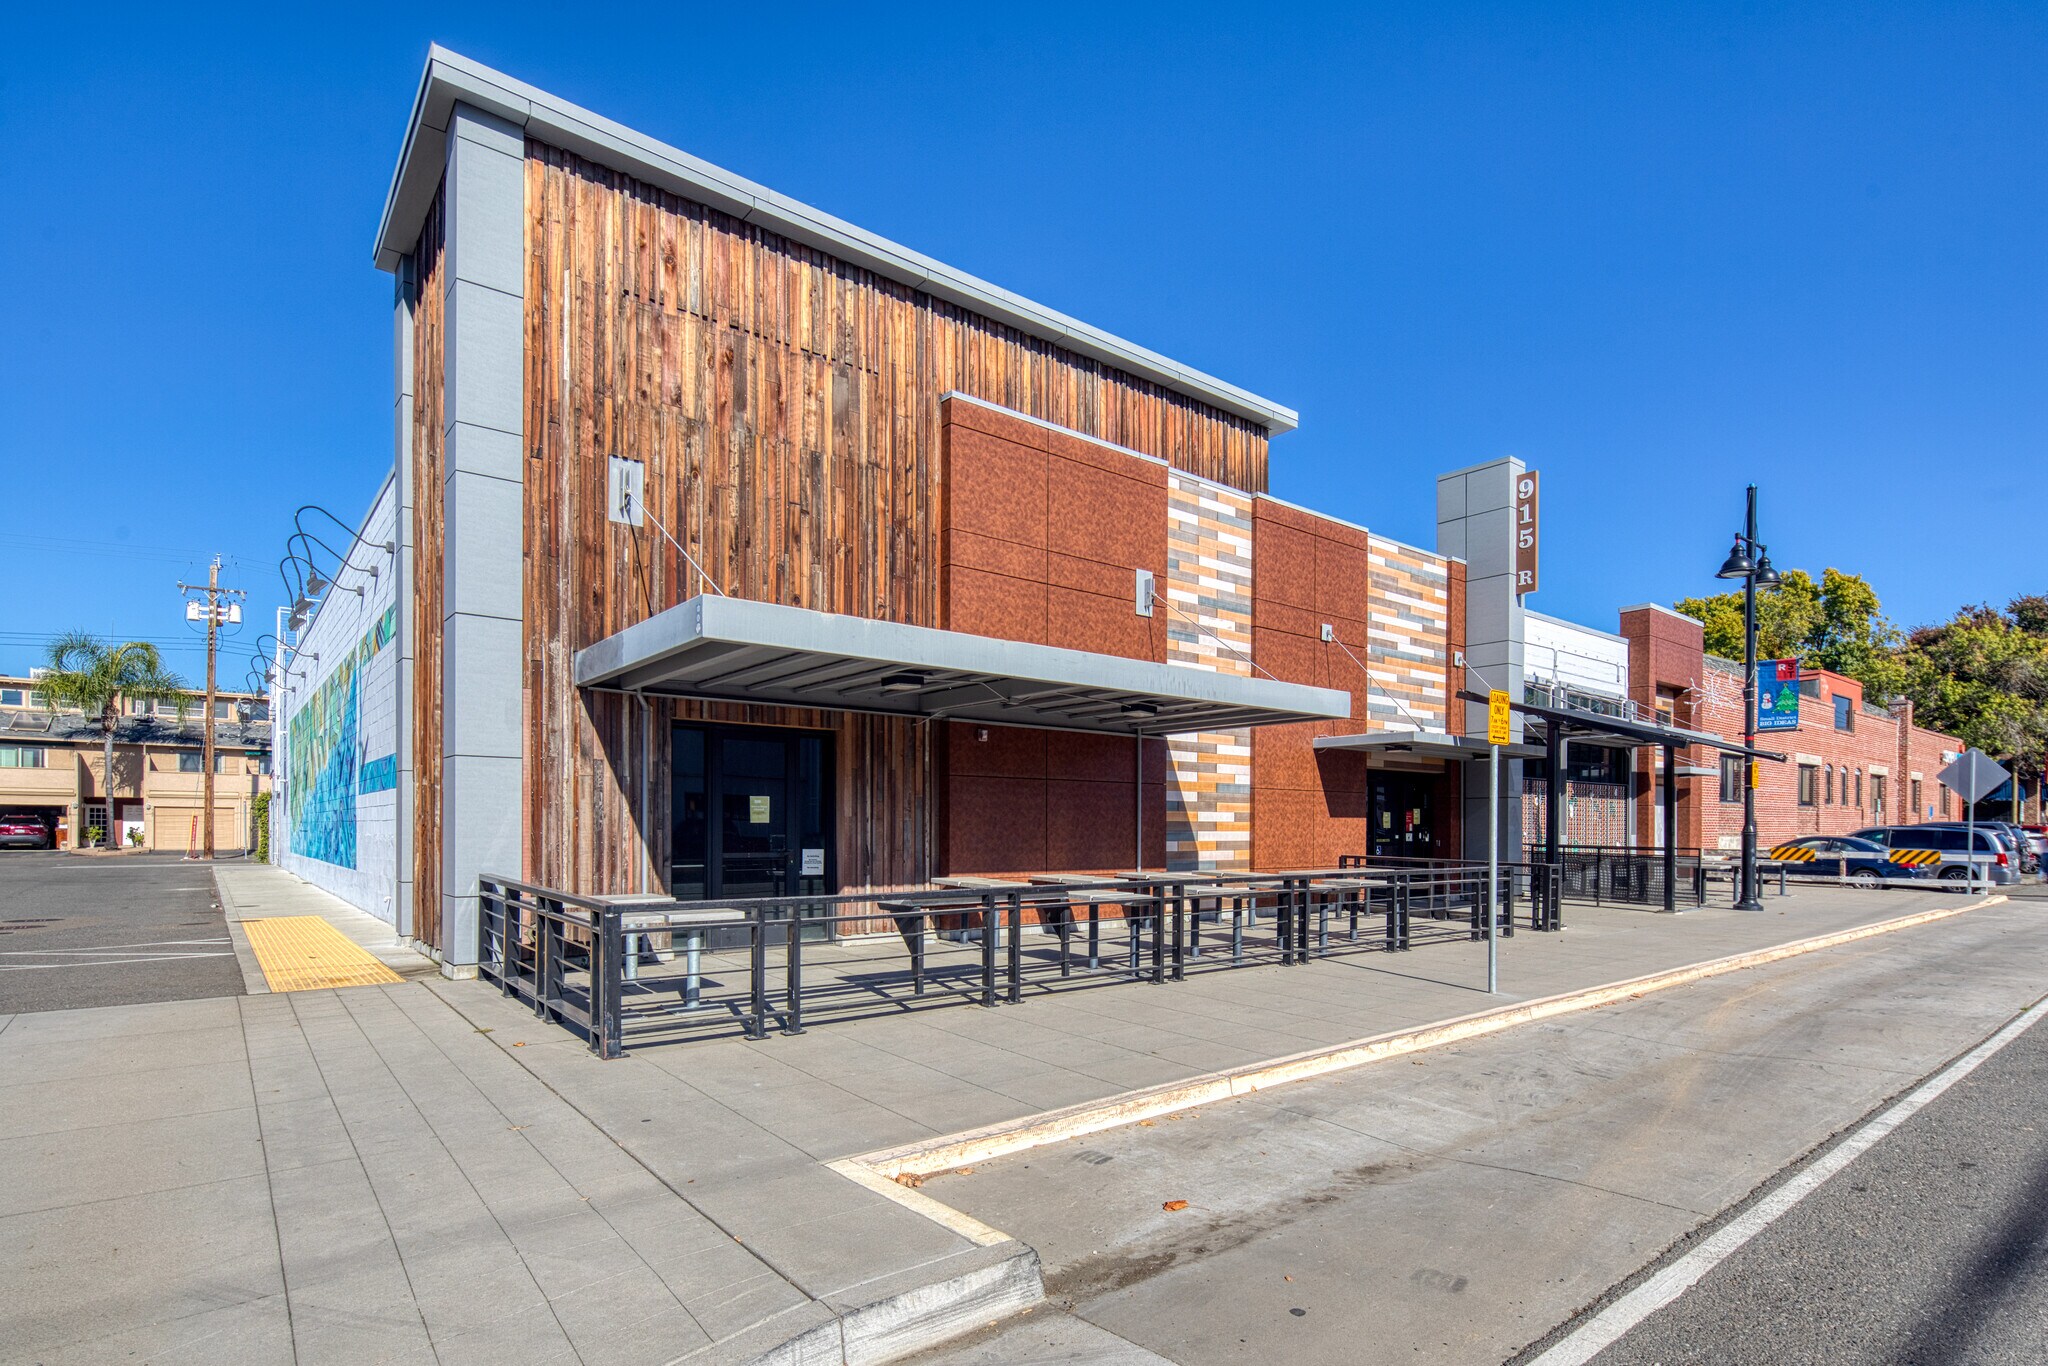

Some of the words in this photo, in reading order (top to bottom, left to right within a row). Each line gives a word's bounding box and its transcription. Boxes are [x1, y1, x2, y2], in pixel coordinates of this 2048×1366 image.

[1518, 479, 1534, 549] 915
[1518, 570, 1533, 585] R
[1491, 693, 1508, 705] LOADING
[1494, 705, 1504, 715] ONLY
